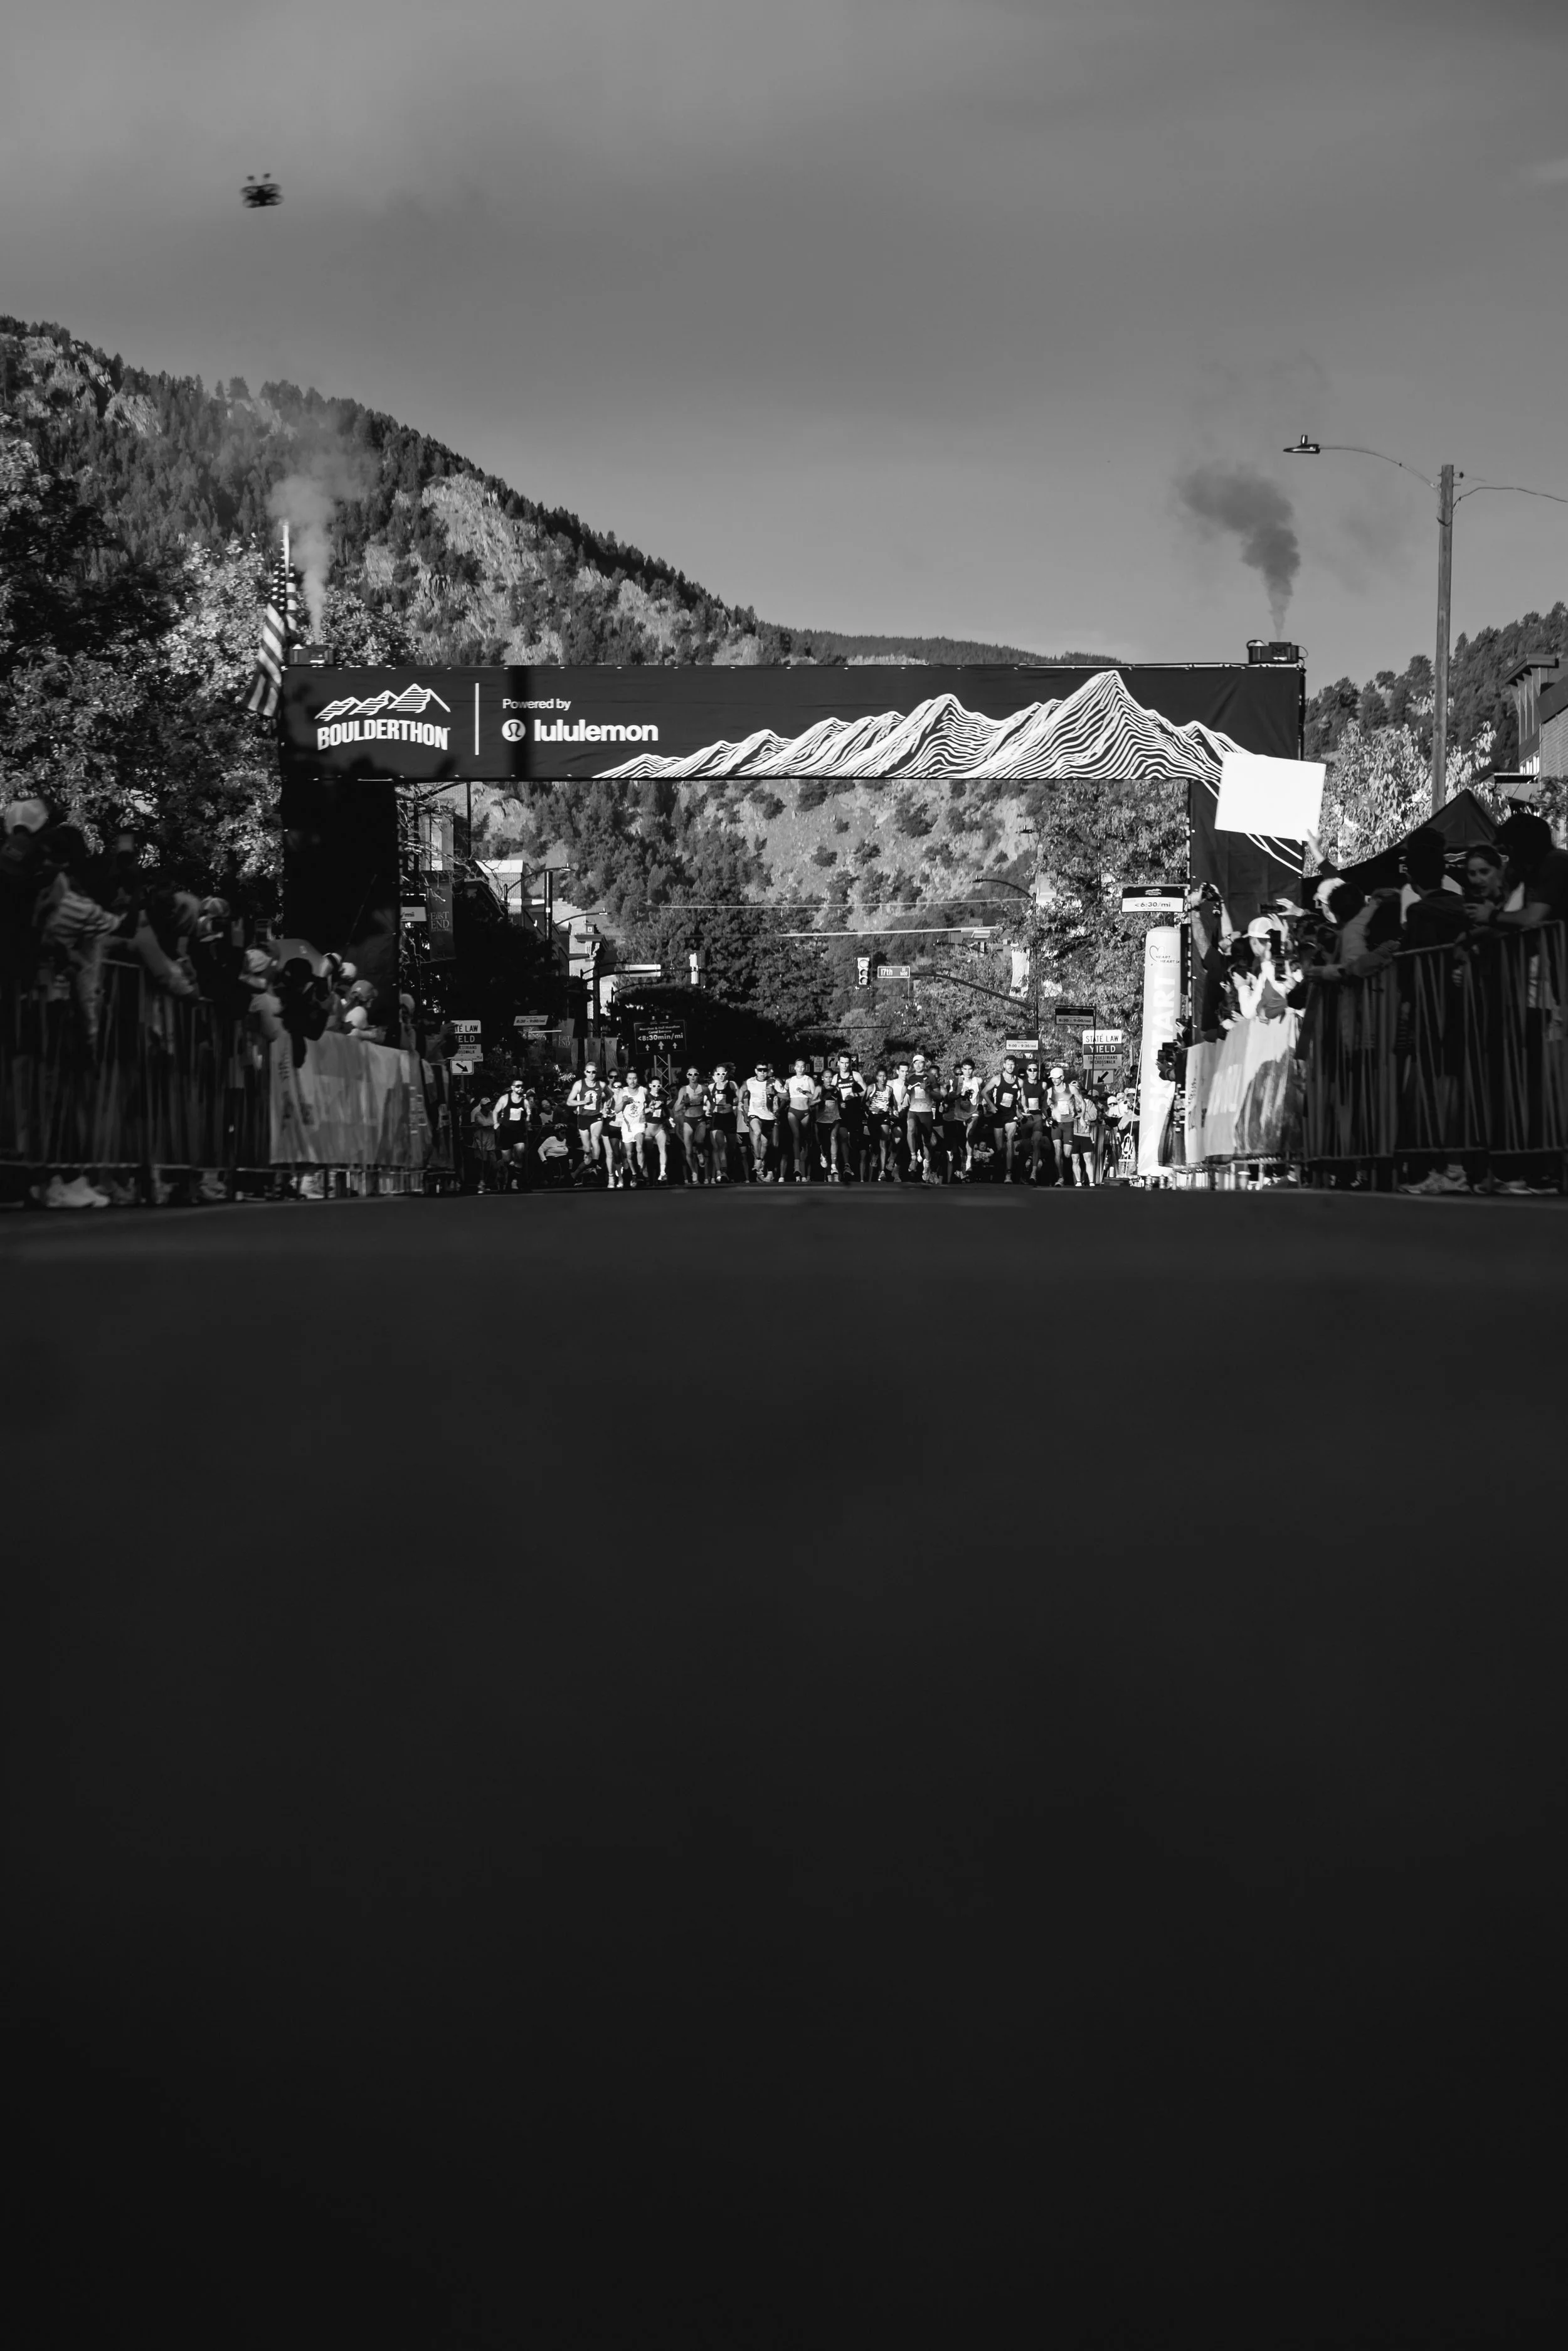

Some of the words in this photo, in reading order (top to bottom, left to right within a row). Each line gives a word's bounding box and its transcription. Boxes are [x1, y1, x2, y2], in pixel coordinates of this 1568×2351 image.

[502, 699, 554, 709] Powered
[556, 699, 571, 711] by
[317, 719, 448, 751] BOULDERTHON
[534, 719, 659, 742] lululemon
[432, 920, 450, 929] END
[881, 968, 893, 976] 17th
[458, 1035, 475, 1043] ELD
[637, 1032, 684, 1041] <8:30min/mi
[1086, 1035, 1103, 1043] STATE
[1089, 1045, 1116, 1053] YIELD
